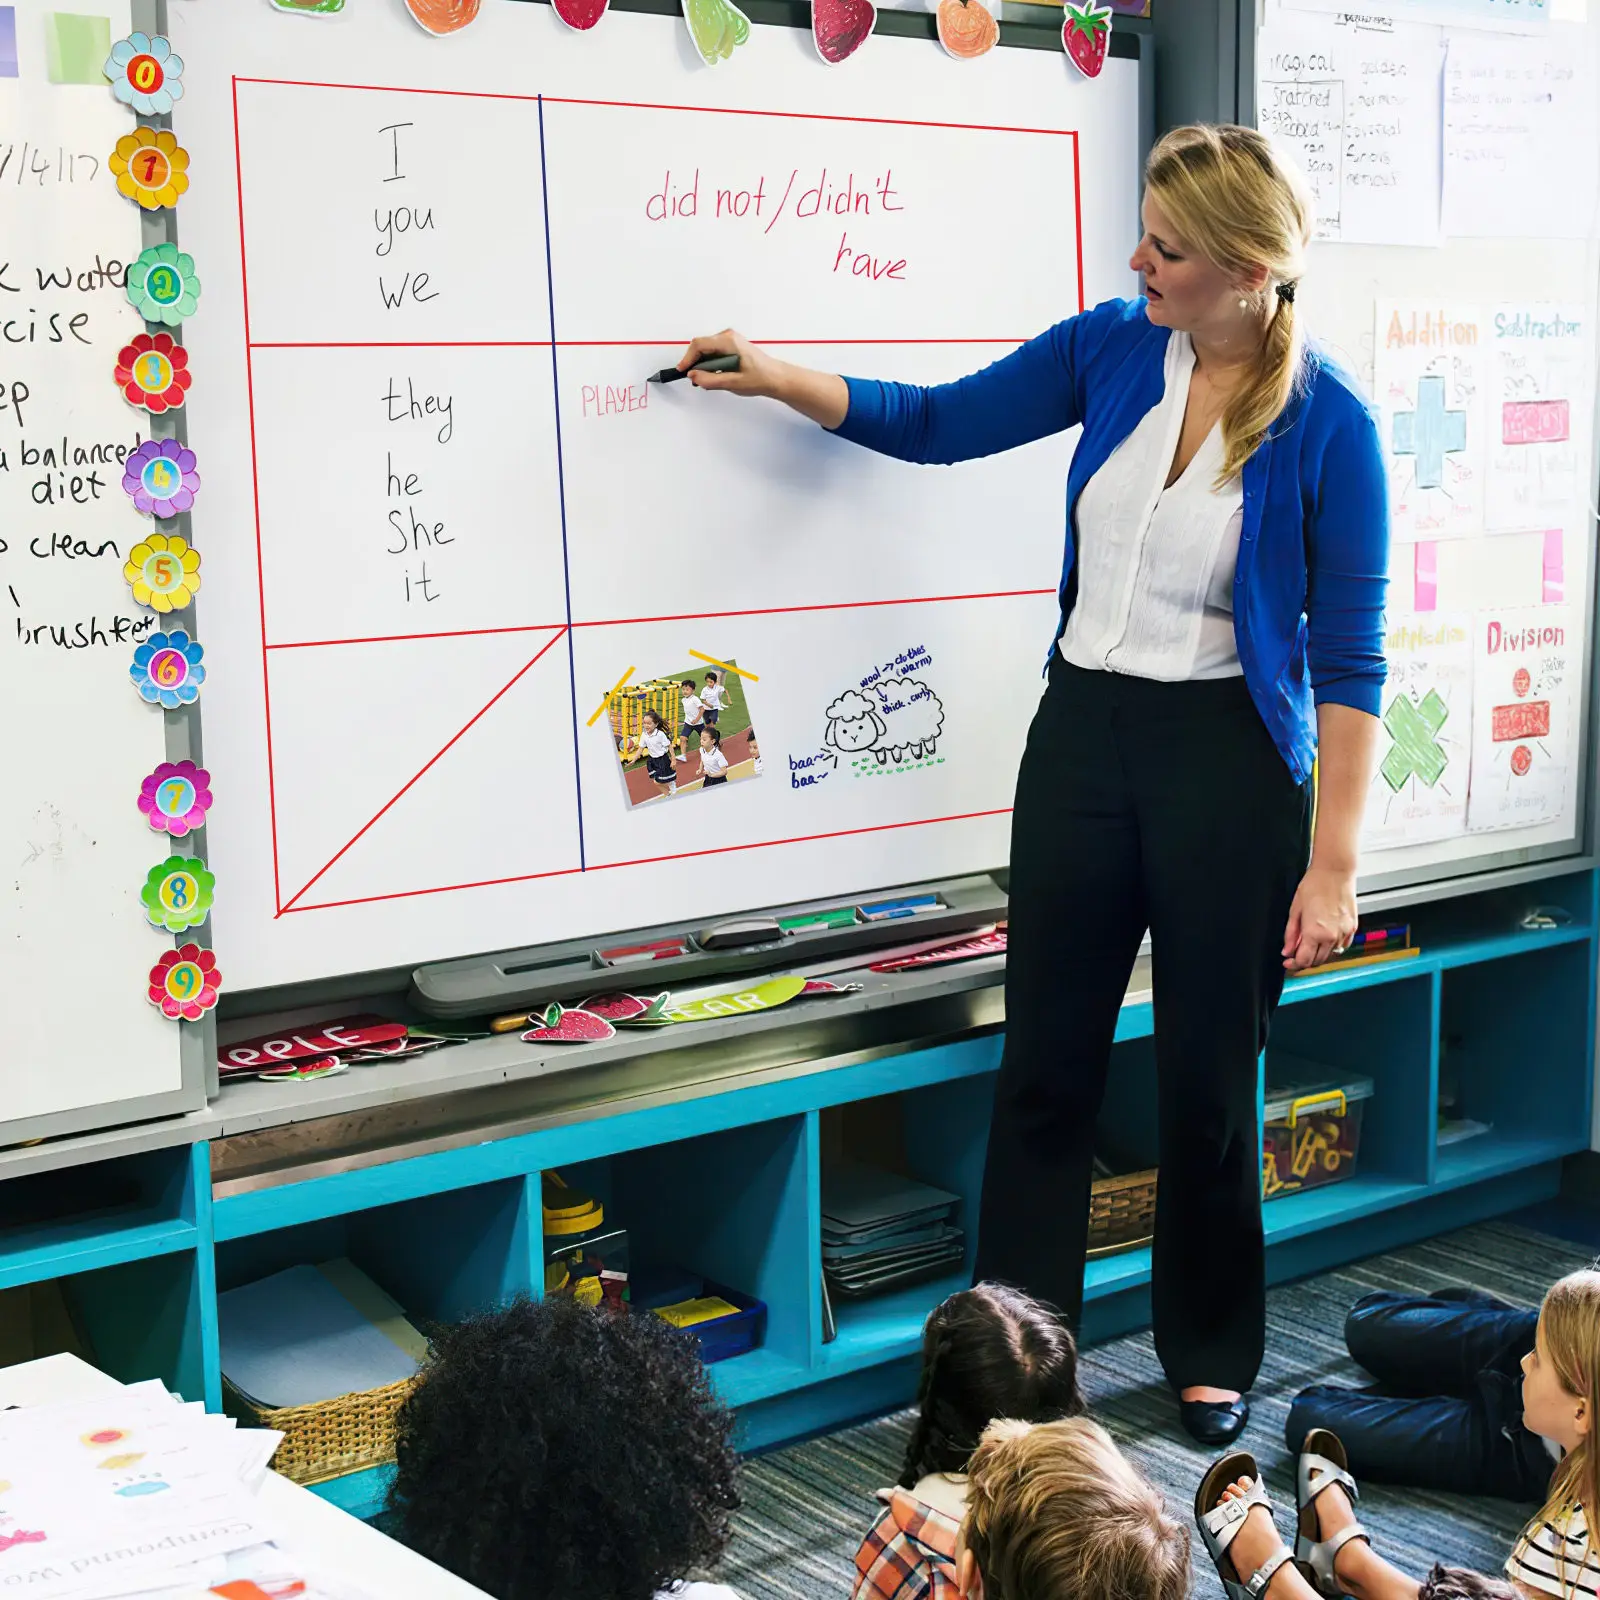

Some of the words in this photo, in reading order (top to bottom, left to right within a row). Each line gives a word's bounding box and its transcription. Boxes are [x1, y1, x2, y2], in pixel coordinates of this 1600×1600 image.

[135, 60, 155, 89] 0
[378, 122, 414, 182] I
[143, 156, 158, 182] 1
[646, 168, 699, 221] did
[375, 207, 434, 256] you
[153, 269, 177, 300] 2
[1386, 309, 1479, 349] Addition
[145, 355, 163, 387] 3
[381, 377, 453, 443] they
[31, 471, 107, 505] diet
[388, 451, 423, 496] he
[30, 532, 121, 559] clean
[154, 559, 173, 587] 5
[405, 560, 440, 602] it
[1487, 620, 1564, 655] Division
[157, 653, 178, 687] 6
[859, 665, 882, 688] wool
[166, 784, 186, 813] 7
[170, 876, 187, 909] 8
[175, 966, 195, 998] 9
[662, 992, 768, 1020] EAR
